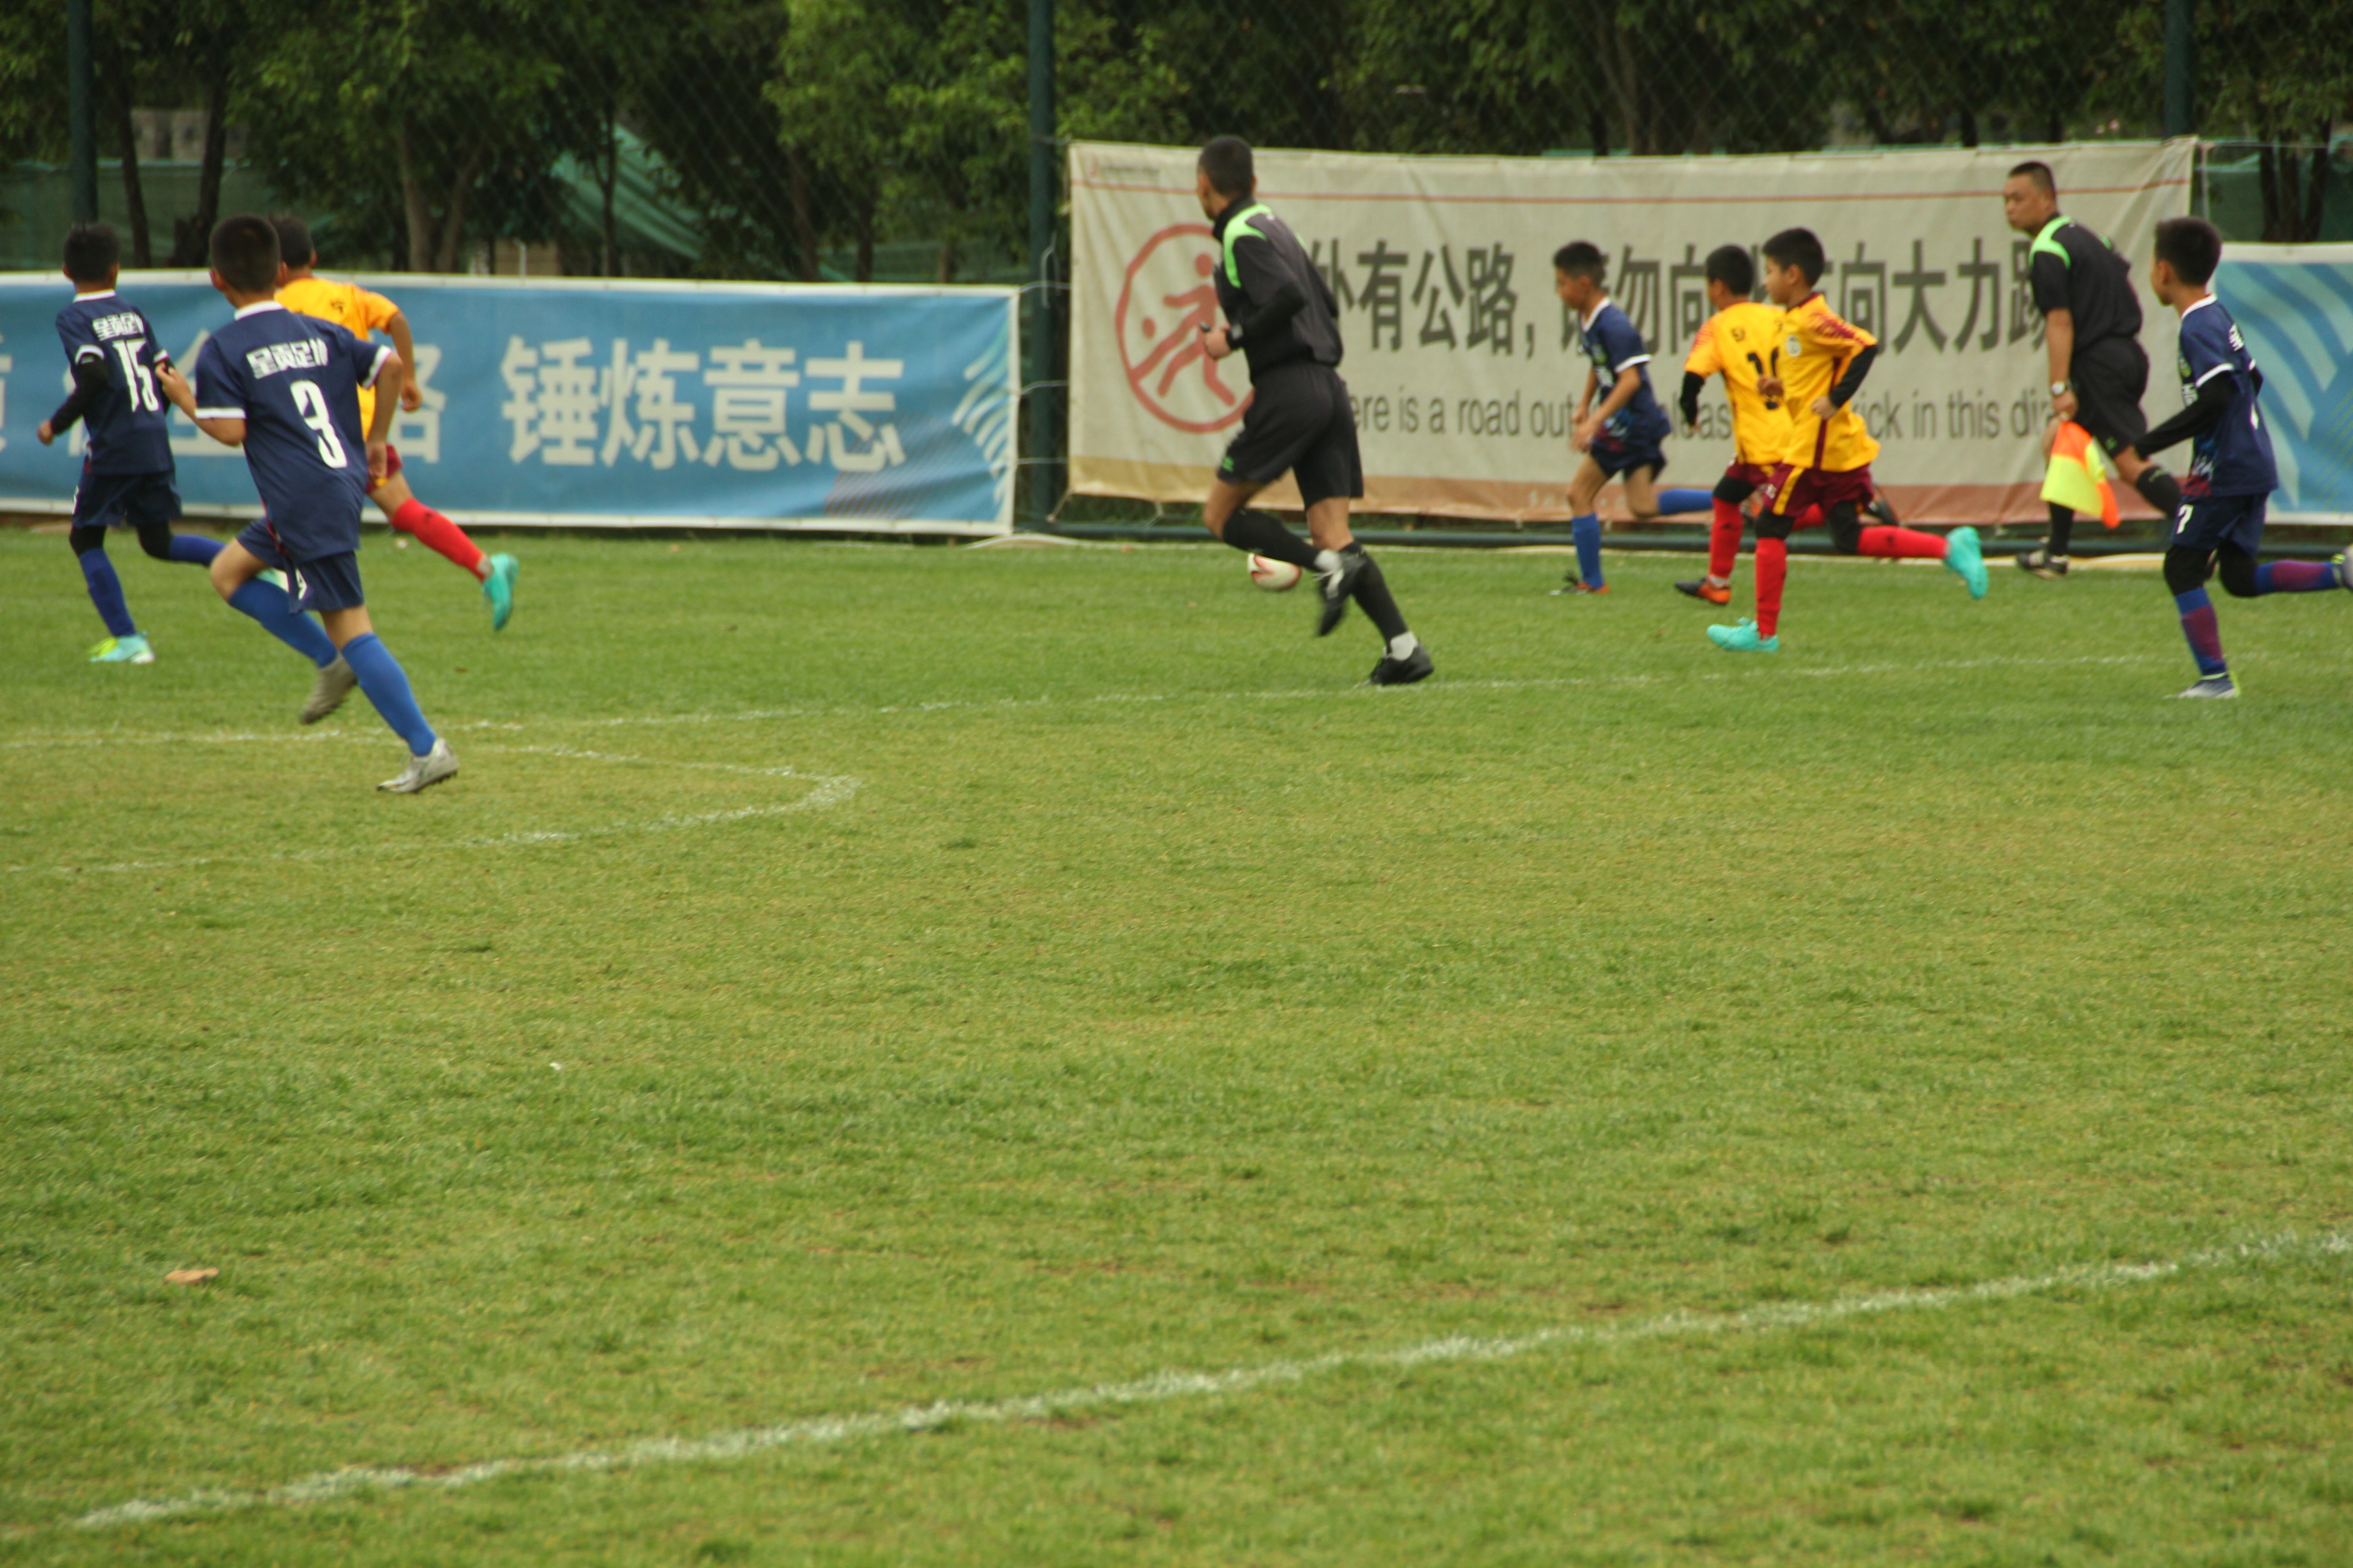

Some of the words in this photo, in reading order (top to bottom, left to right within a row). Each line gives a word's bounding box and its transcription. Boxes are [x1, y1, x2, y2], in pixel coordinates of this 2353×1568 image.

[112, 338, 160, 412] 15
[500, 335, 906, 473] 锤炼意志
[1399, 384, 1419, 434] is
[1428, 396, 1446, 435] a
[1458, 389, 1520, 437] road
[1911, 388, 1937, 438] in
[1946, 388, 2000, 440] this
